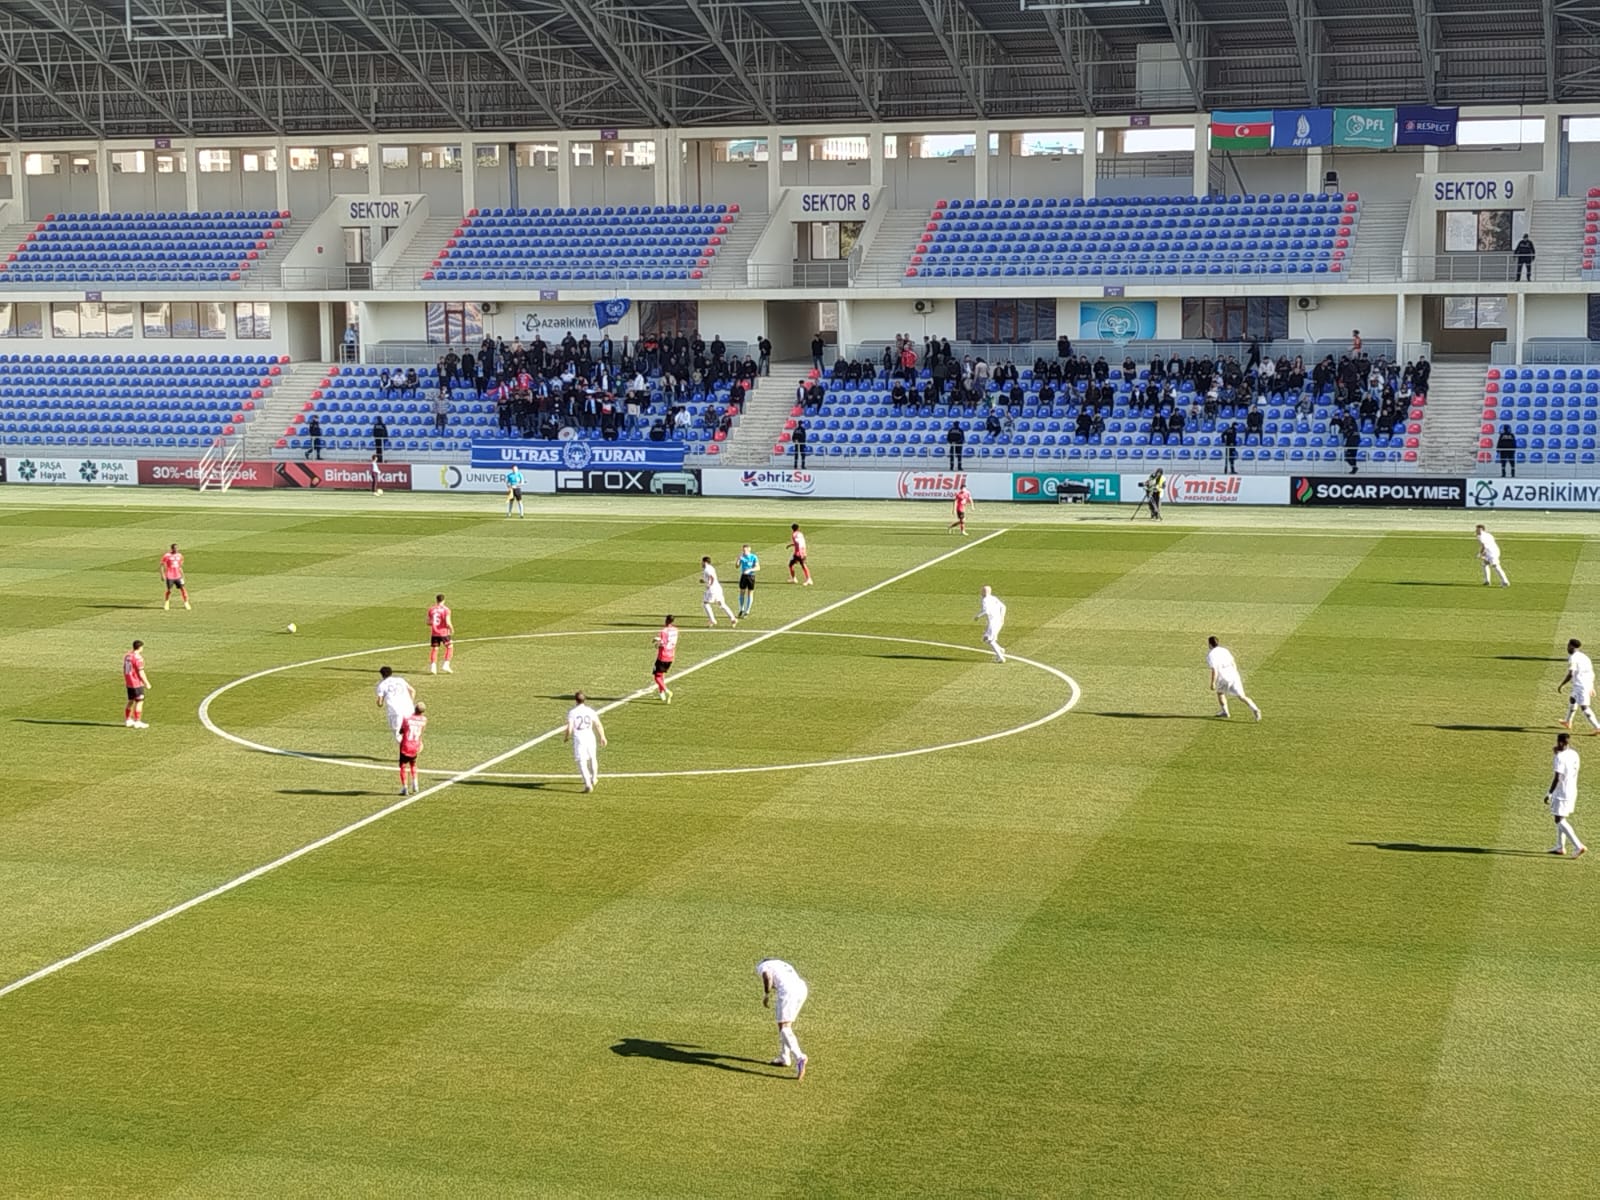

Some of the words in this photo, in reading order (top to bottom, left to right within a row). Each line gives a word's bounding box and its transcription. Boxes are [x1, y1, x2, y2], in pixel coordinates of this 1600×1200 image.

[1365, 118, 1385, 131] PFL
[1417, 122, 1450, 131] RESPECT
[1292, 138, 1312, 146] AFFA
[1435, 181, 1497, 200] SEKTOR
[1504, 180, 1514, 199] 9
[350, 202, 399, 219] SEKTOR
[404, 201, 412, 216] 7
[802, 194, 856, 212] SEKTOR
[862, 193, 870, 211] 8
[501, 448, 559, 461] ULTRAS
[592, 449, 646, 461] TURAN
[324, 469, 373, 482] Birbank
[377, 471, 408, 483] kartı
[913, 473, 967, 490] misli
[1184, 477, 1241, 494] misli
[1317, 484, 1377, 498] SOCAR
[1379, 485, 1460, 500] POLYMER
[1502, 482, 1600, 502] AZƏRİKİMY
[576, 715, 591, 730] 29
